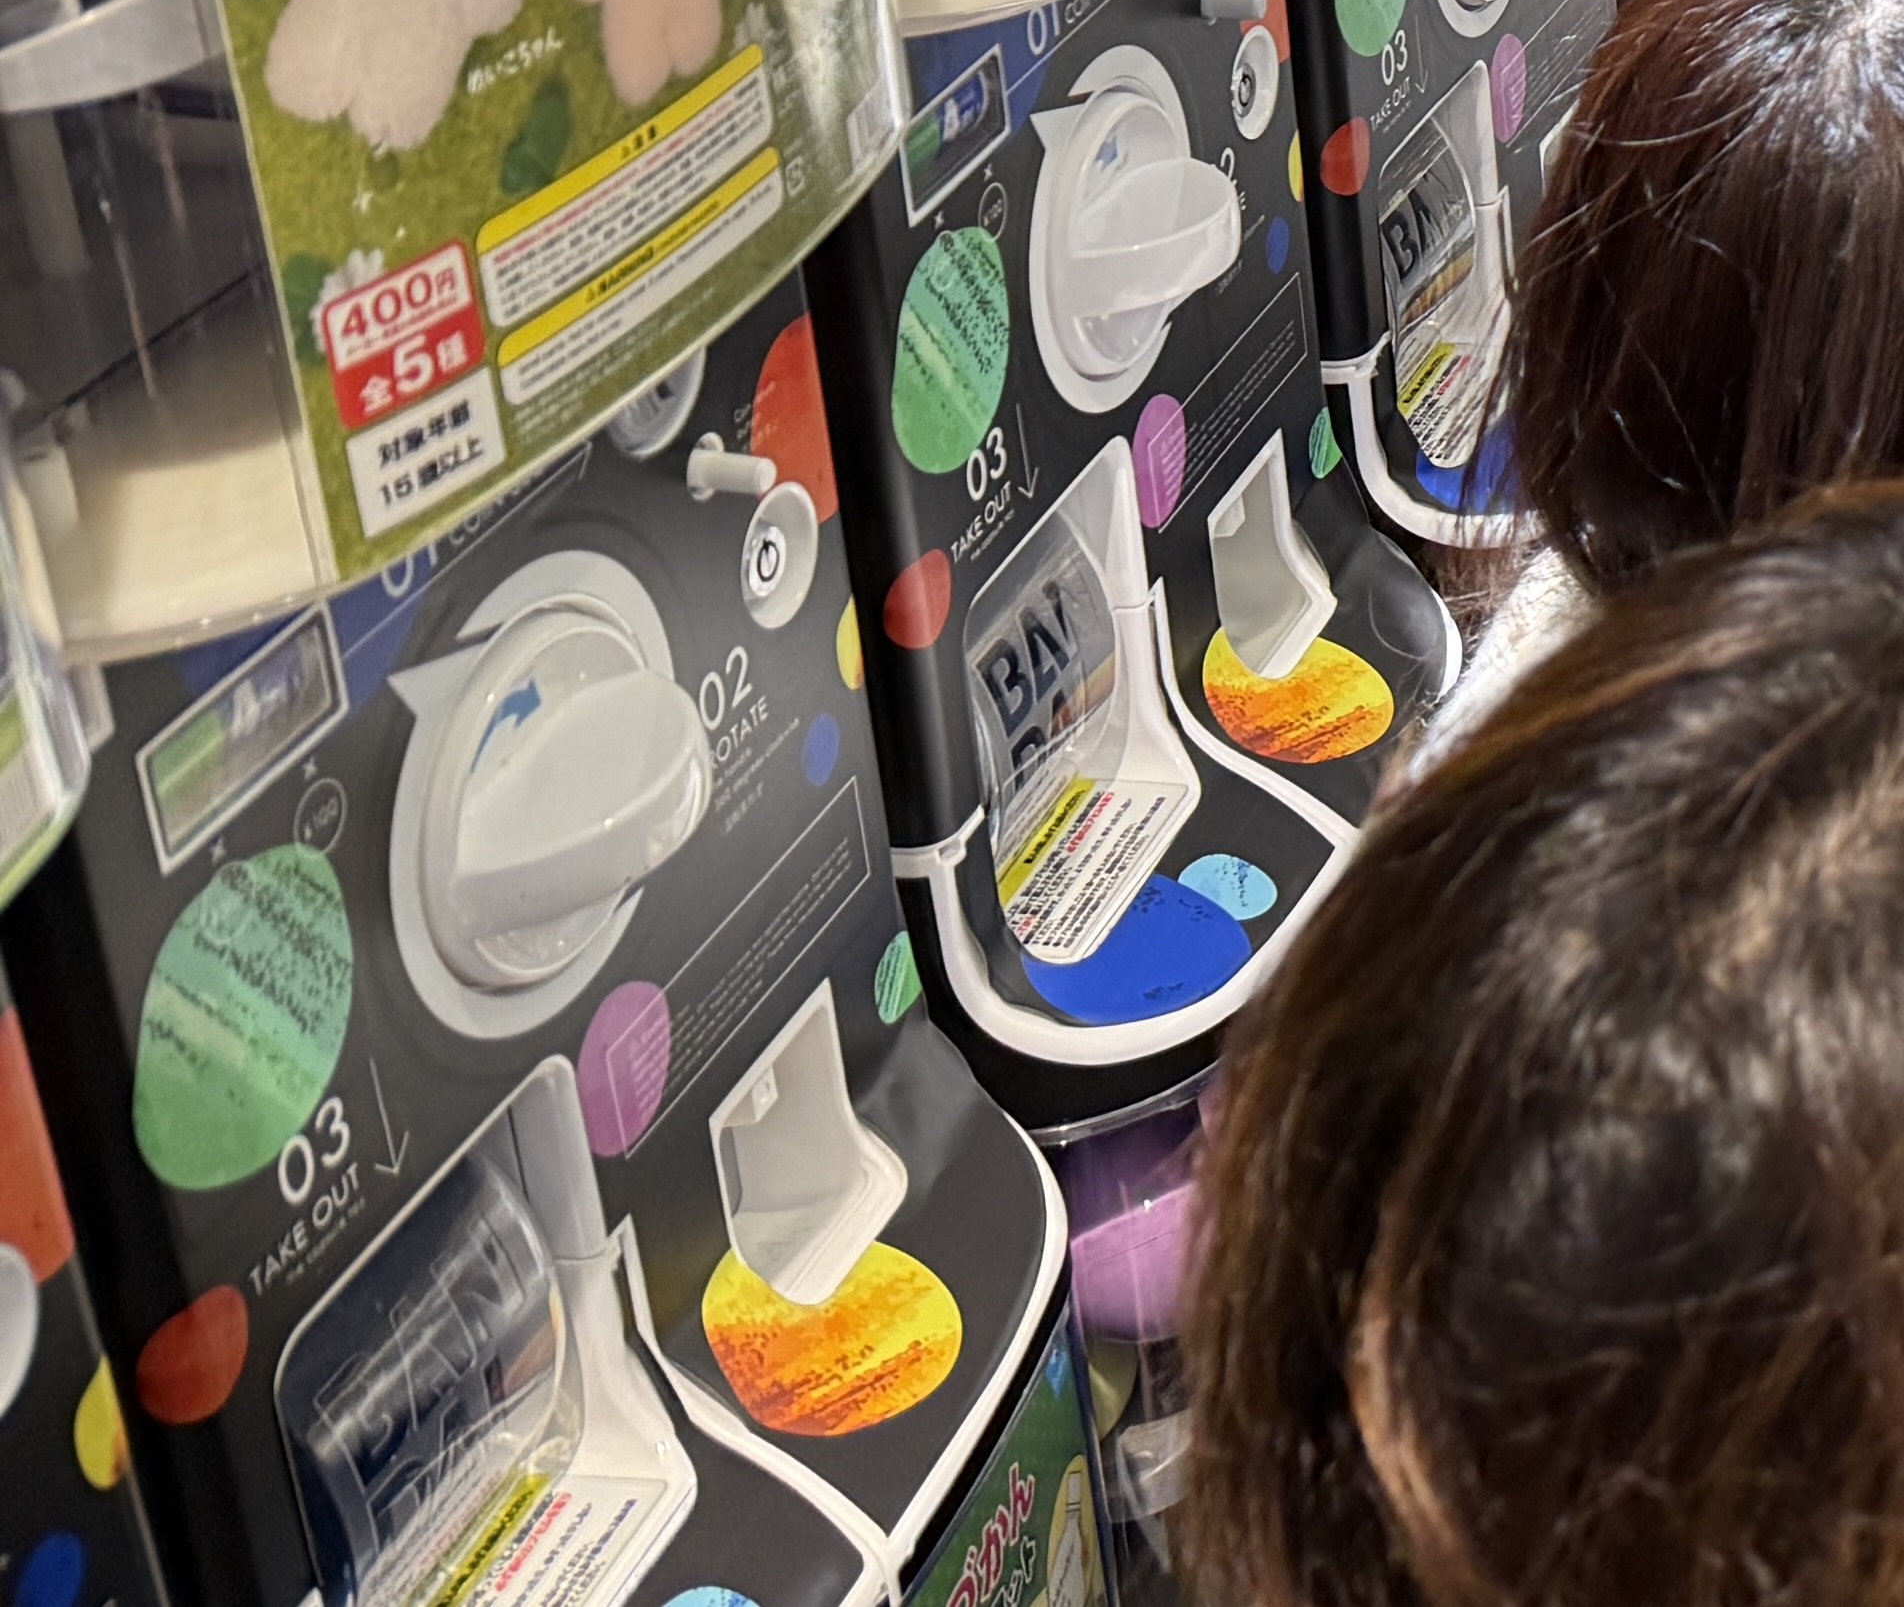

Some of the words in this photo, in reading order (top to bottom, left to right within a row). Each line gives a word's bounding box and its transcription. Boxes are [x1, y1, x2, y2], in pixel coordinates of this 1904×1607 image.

[1026, 2, 1062, 56] 01
[1379, 27, 1410, 87] 03
[340, 265, 457, 340] 400円
[965, 426, 1008, 503] 03
[950, 516, 985, 565] TAKE
[983, 481, 1014, 522] OUT
[698, 644, 754, 732] 02
[277, 1096, 352, 1206] 03
[248, 1221, 312, 1296] TAKE
[311, 1159, 363, 1229] OUT
